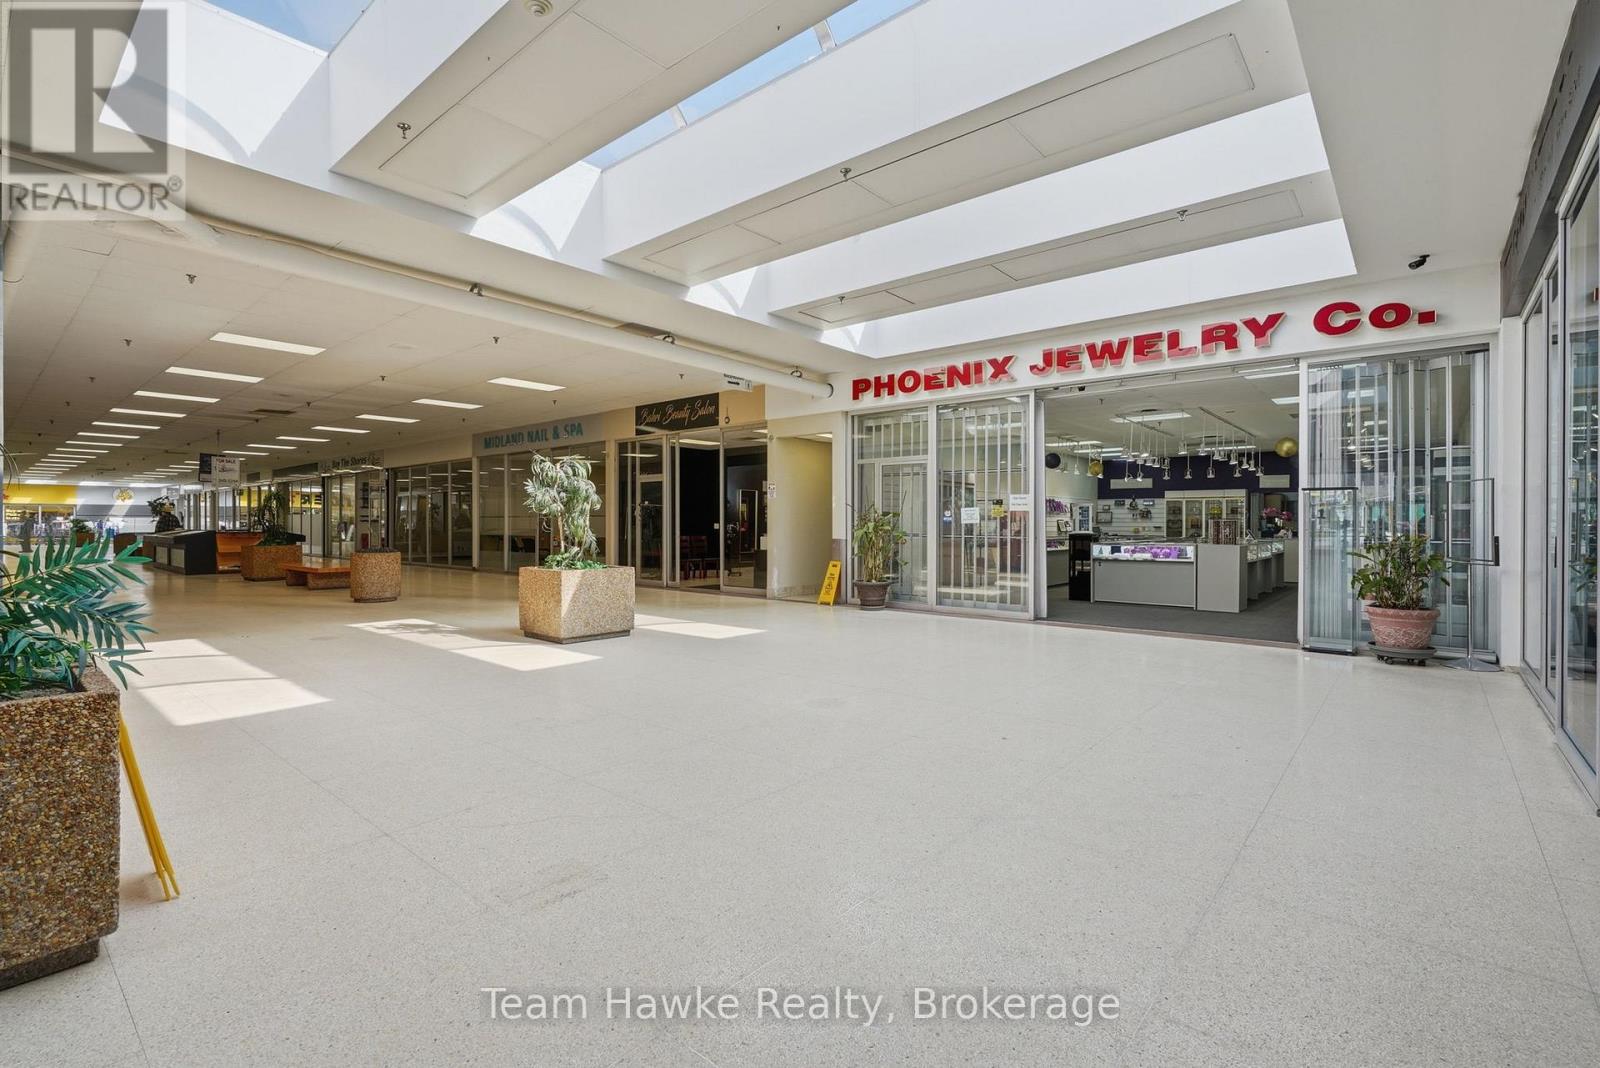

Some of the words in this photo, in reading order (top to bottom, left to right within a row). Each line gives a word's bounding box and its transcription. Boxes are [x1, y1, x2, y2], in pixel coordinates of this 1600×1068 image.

[850, 356, 1015, 401] PHOENIX
[1028, 312, 1285, 375] JEWELRY
[1312, 301, 1437, 337] Co.
[691, 399, 716, 420] Salon
[484, 431, 524, 449] MIDLAND
[527, 428, 549, 443] NAIL
[552, 425, 560, 440] &
[564, 421, 583, 437] SPA
